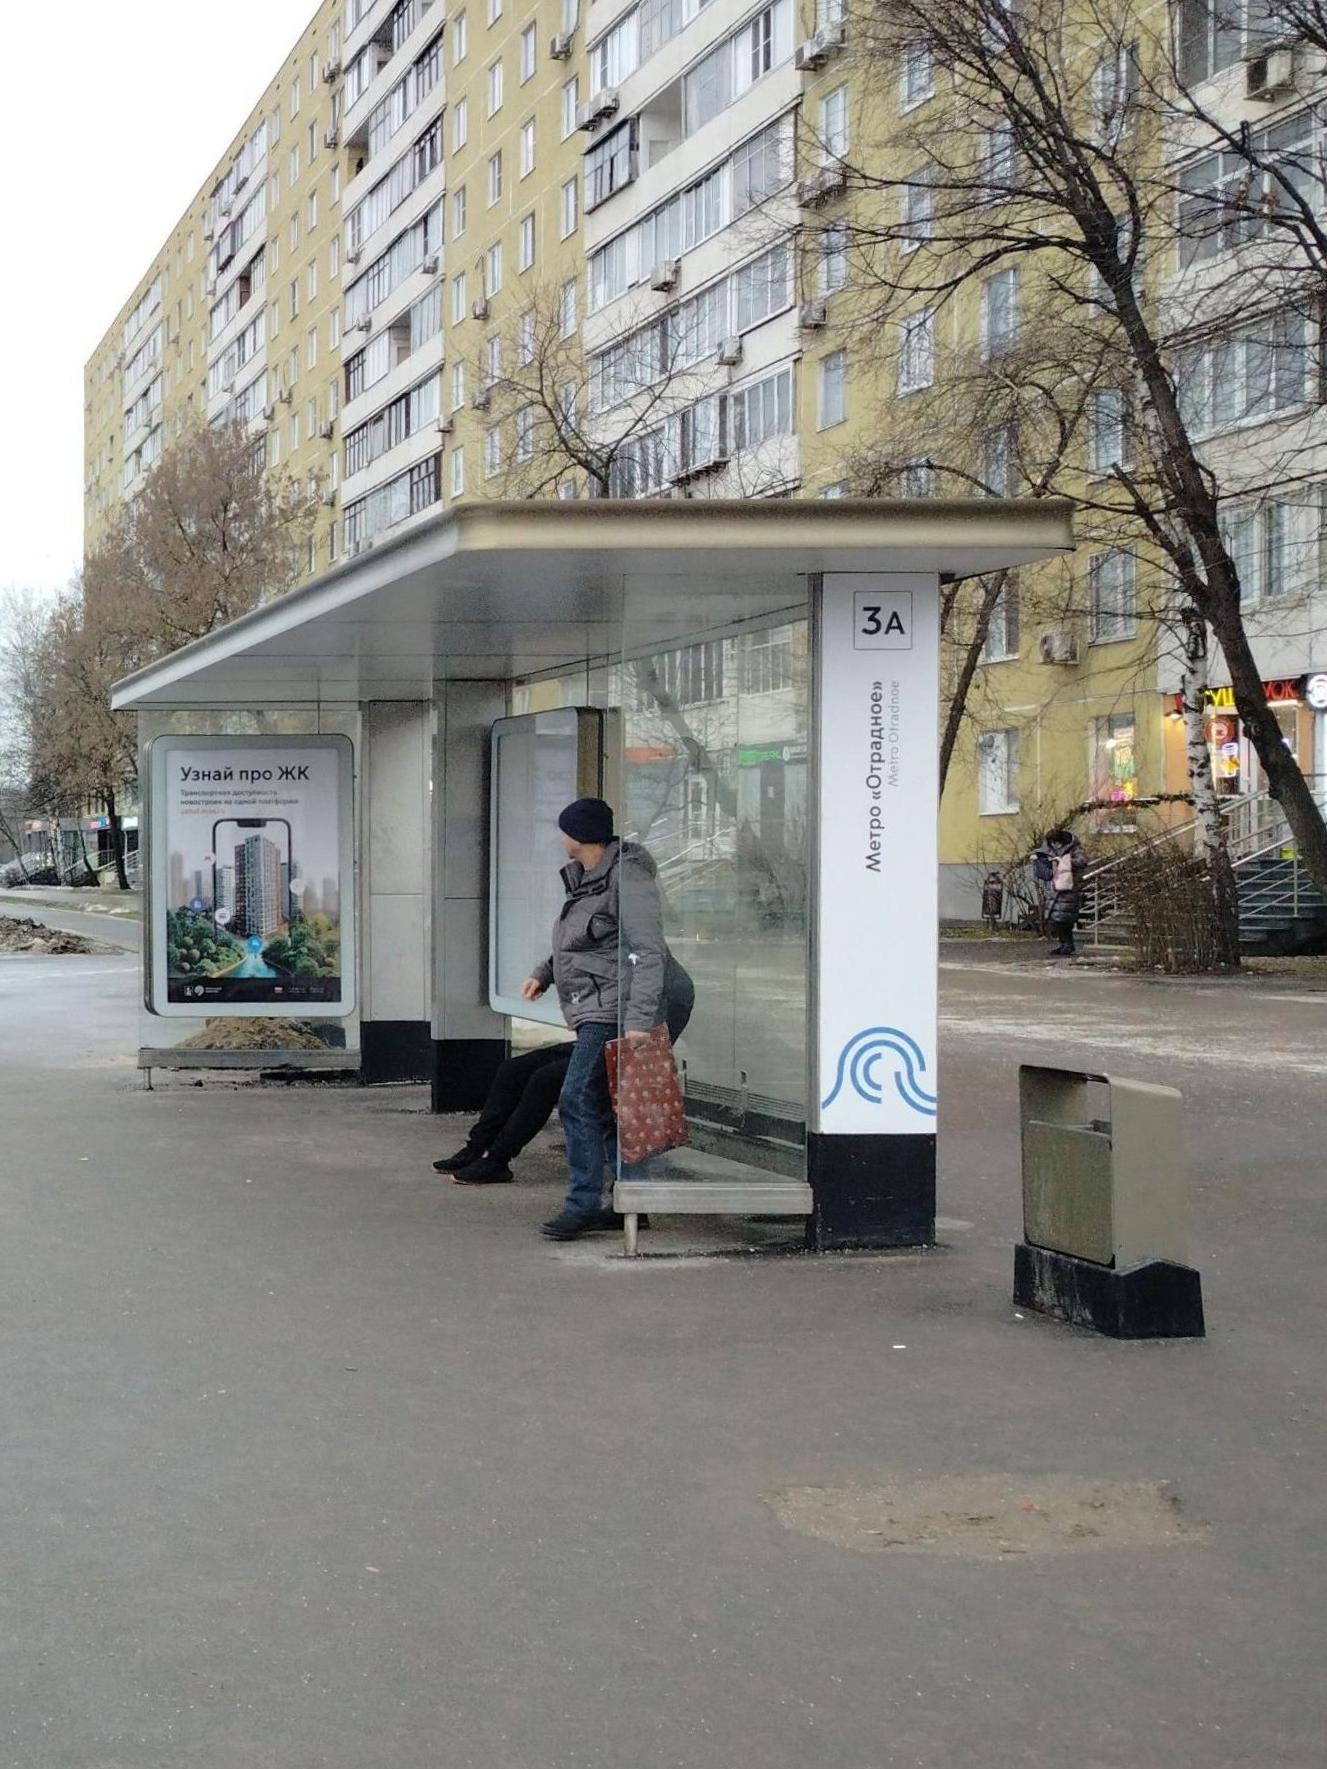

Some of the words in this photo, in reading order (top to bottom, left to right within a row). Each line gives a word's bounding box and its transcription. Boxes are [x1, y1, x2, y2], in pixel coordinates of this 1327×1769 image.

[866, 680, 885, 800] «Отрадное»
[888, 680, 900, 743] Otradnoe
[180, 766, 233, 781] Узнай
[239, 769, 273, 784] про
[277, 766, 310, 781] ЖК
[888, 746, 900, 787] Metro
[865, 805, 885, 873] Метро
